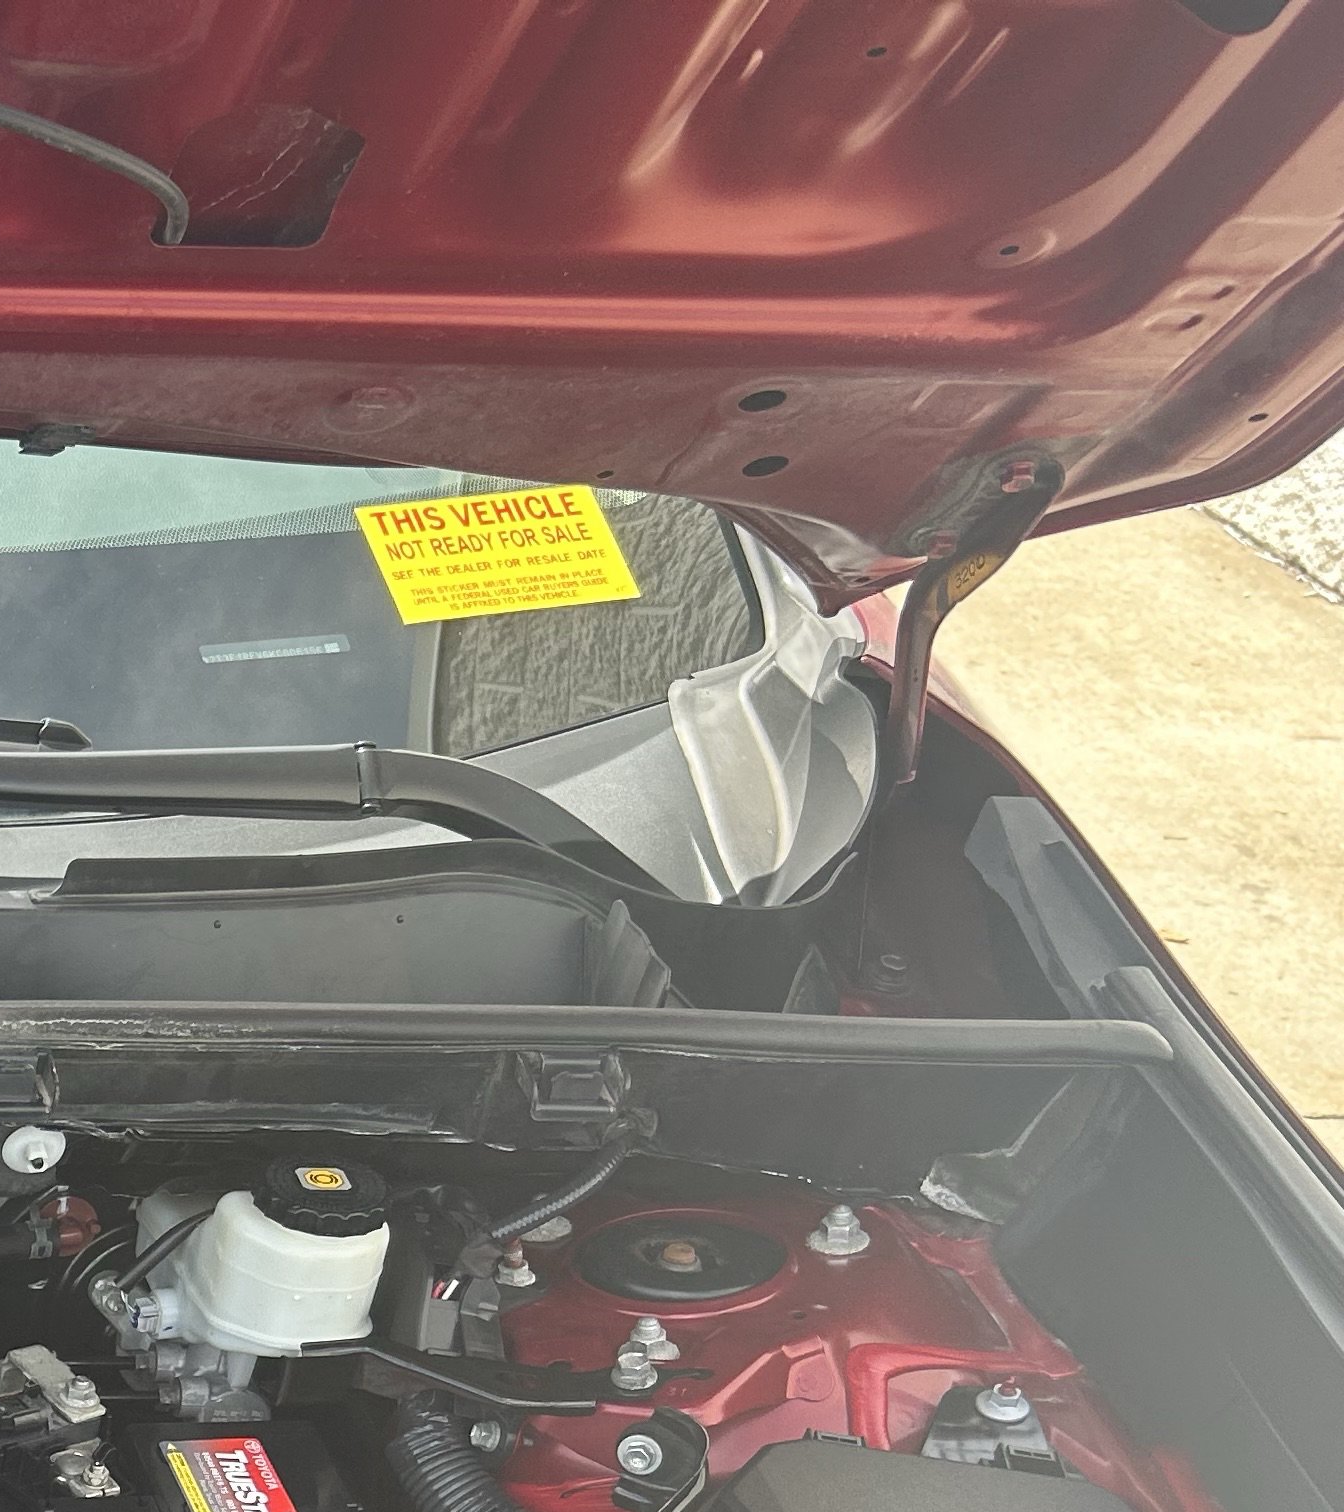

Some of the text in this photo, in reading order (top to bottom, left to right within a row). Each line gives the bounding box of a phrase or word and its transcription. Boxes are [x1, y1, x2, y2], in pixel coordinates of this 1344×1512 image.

[369, 492, 583, 536] THIS VEHICLE
[385, 522, 593, 561] NOT READY FOR SALE
[392, 548, 607, 580] SEE THE DEALER FOR RESALE DATE
[436, 582, 480, 593] STICKER
[251, 1453, 280, 1491] TOYOTA
